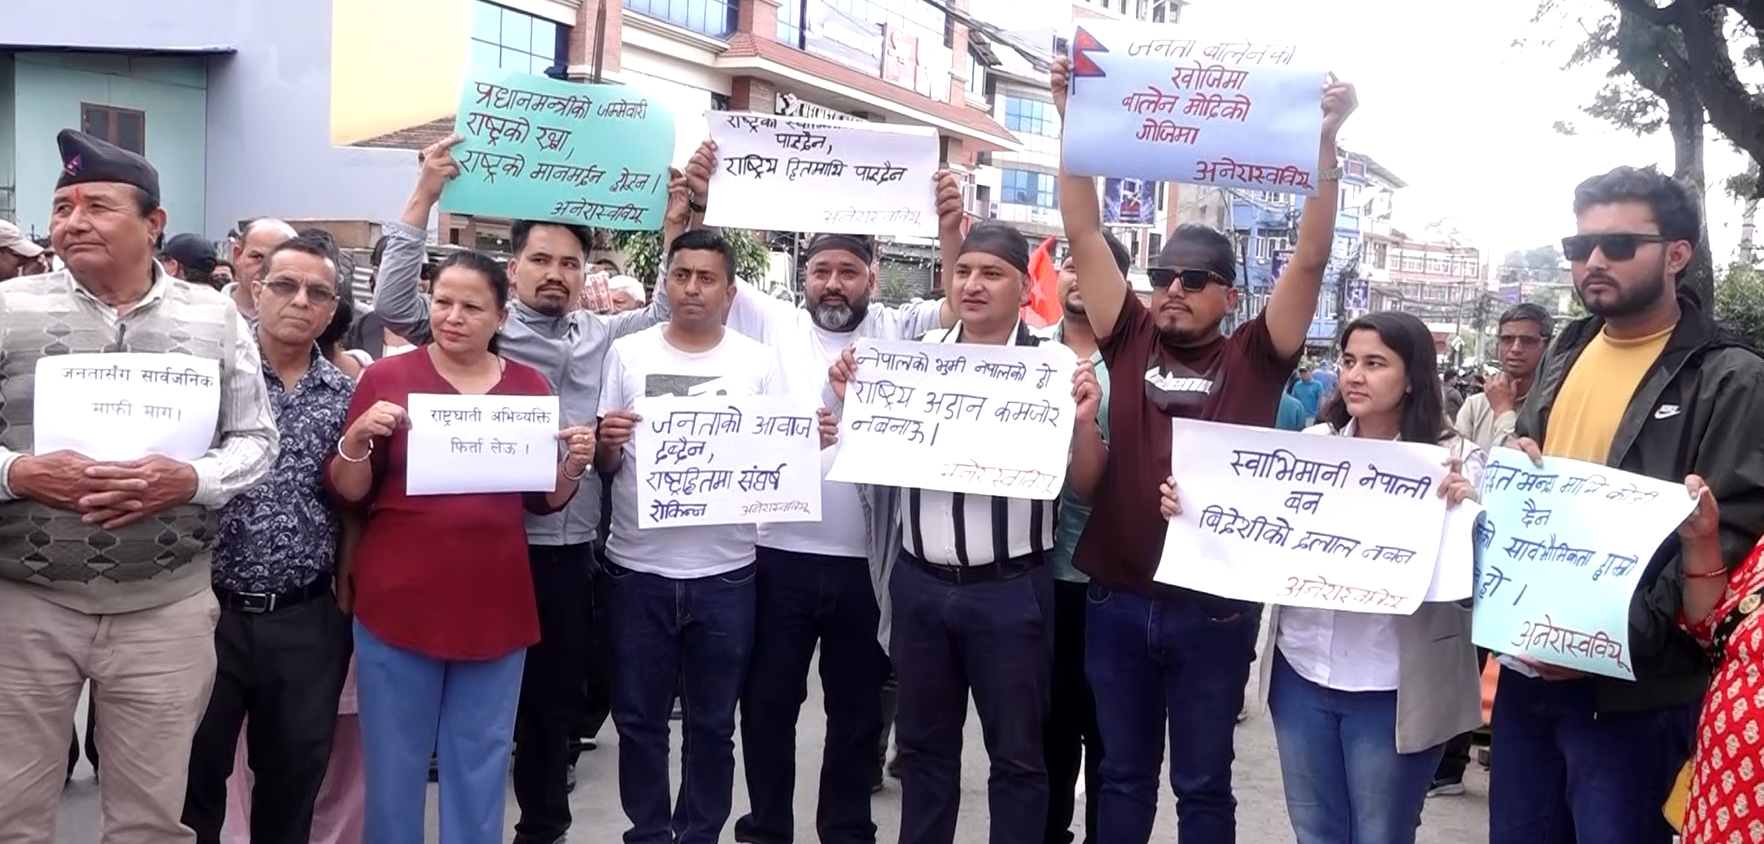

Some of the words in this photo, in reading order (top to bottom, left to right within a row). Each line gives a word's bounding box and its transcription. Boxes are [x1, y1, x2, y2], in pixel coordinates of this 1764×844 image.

[466, 112, 530, 146] राष्ट्रको
[459, 149, 525, 184] राष्ट्रको
[141, 367, 215, 388] सार्वजनिक
[856, 347, 929, 373] नेपालको
[974, 360, 1027, 381] नेपालको
[92, 399, 132, 417] माफी
[430, 407, 482, 427] राष्ट्रघाती
[491, 407, 552, 423] अभिव्यक्ति
[652, 406, 742, 436] जनताको
[752, 416, 812, 438] आवाज
[924, 391, 988, 421] अडान
[994, 399, 1061, 428] कमजोर
[451, 437, 483, 453] फिर्ता
[490, 438, 518, 455] लेऊ
[738, 463, 787, 492] संघर्ष
[1230, 448, 1351, 489] स्वाभिमानी
[1359, 464, 1431, 500] नेपाली
